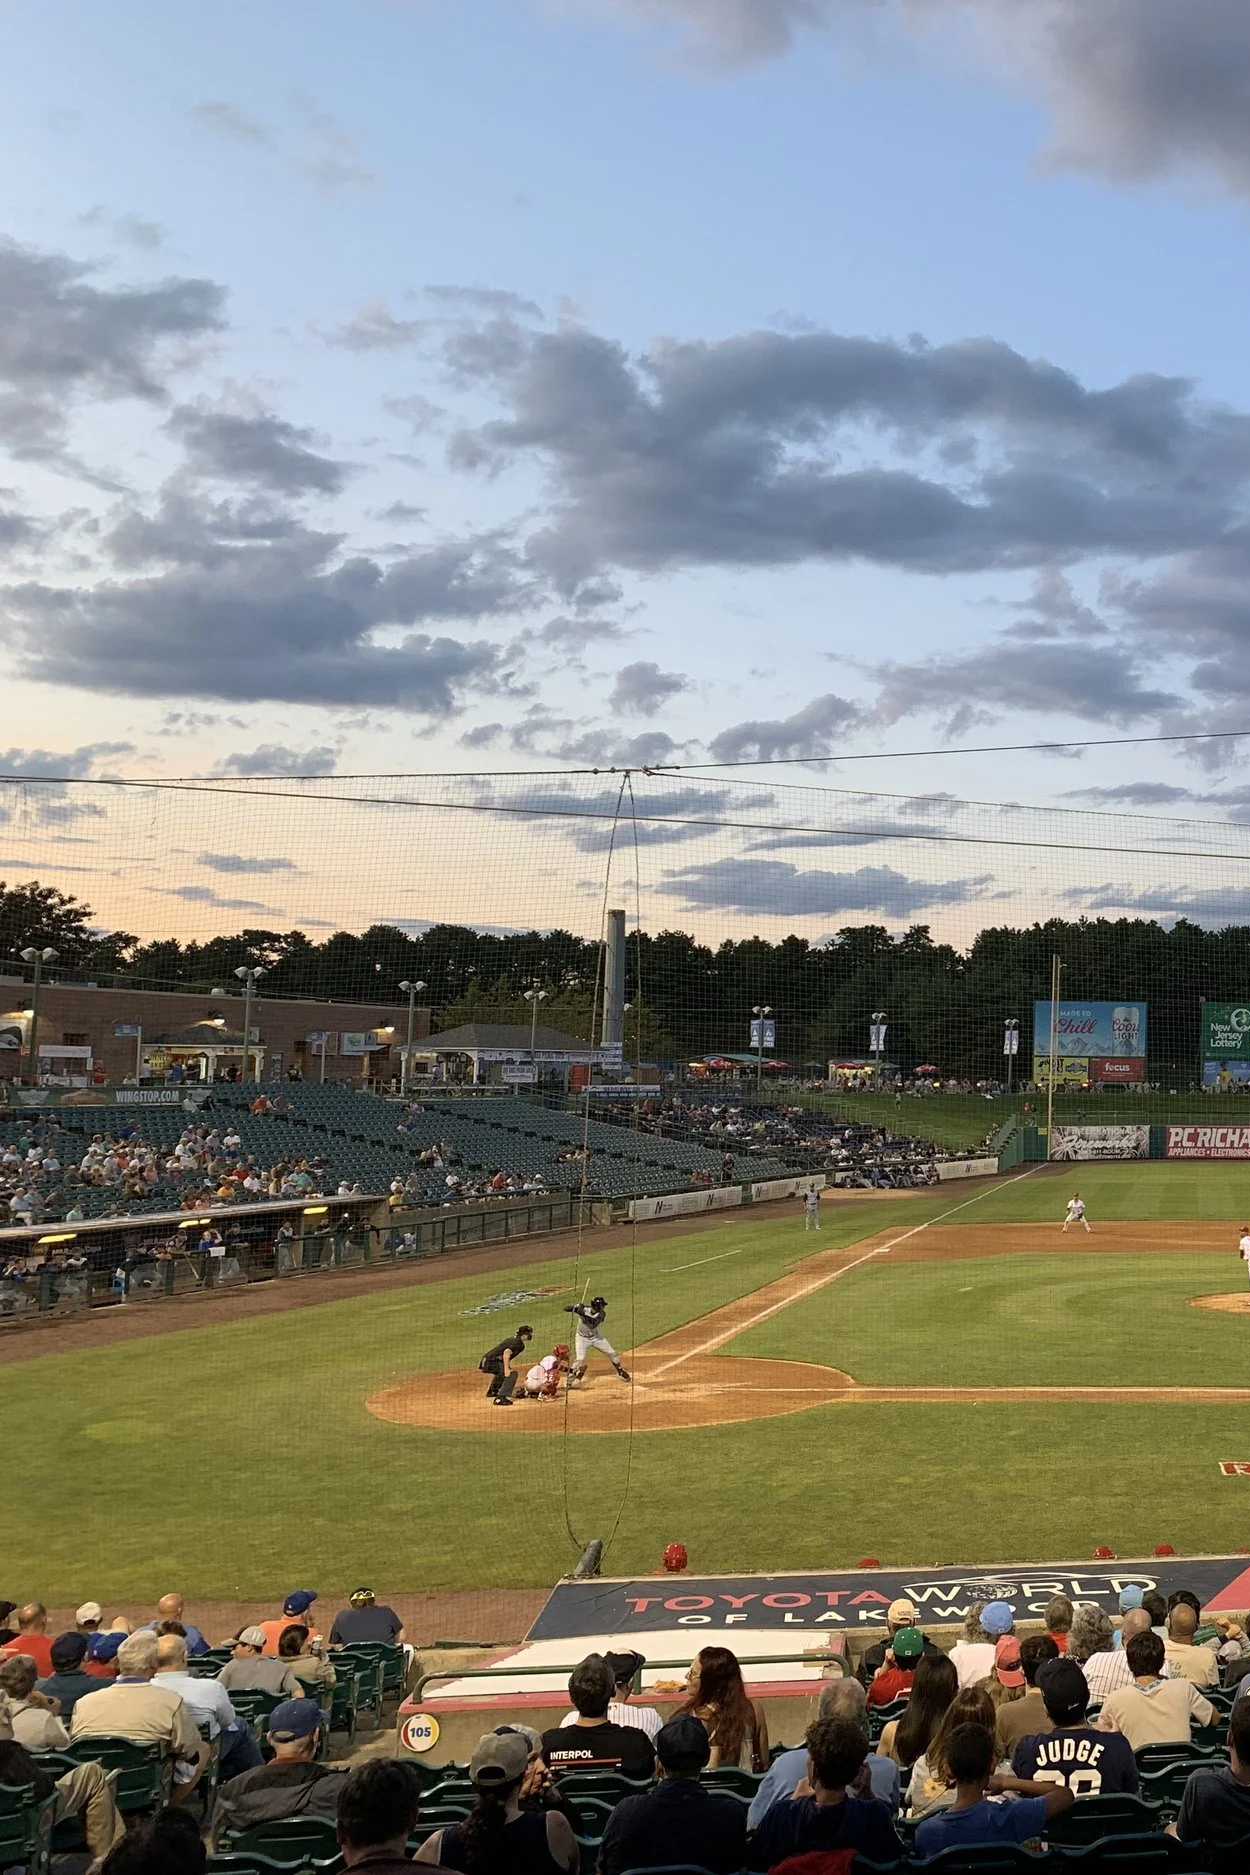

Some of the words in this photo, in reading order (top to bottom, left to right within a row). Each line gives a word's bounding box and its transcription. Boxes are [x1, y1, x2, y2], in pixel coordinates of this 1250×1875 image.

[1210, 1022, 1231, 1032] New
[1215, 1031, 1243, 1041] Jersey
[1210, 1039, 1243, 1049] Lottery
[1104, 1062, 1130, 1072] focus
[116, 1090, 179, 1103] WINGSTOP.COM
[1168, 1148, 1206, 1157] APPLIANCES
[1210, 1148, 1250, 1157] ELECTRONICS
[625, 1590, 895, 1614] TOYOTA
[677, 1612, 748, 1625] OF
[409, 1726, 432, 1738] 105
[549, 1749, 594, 1760] INTERPOL
[1035, 1738, 1105, 1767] JUDGE
